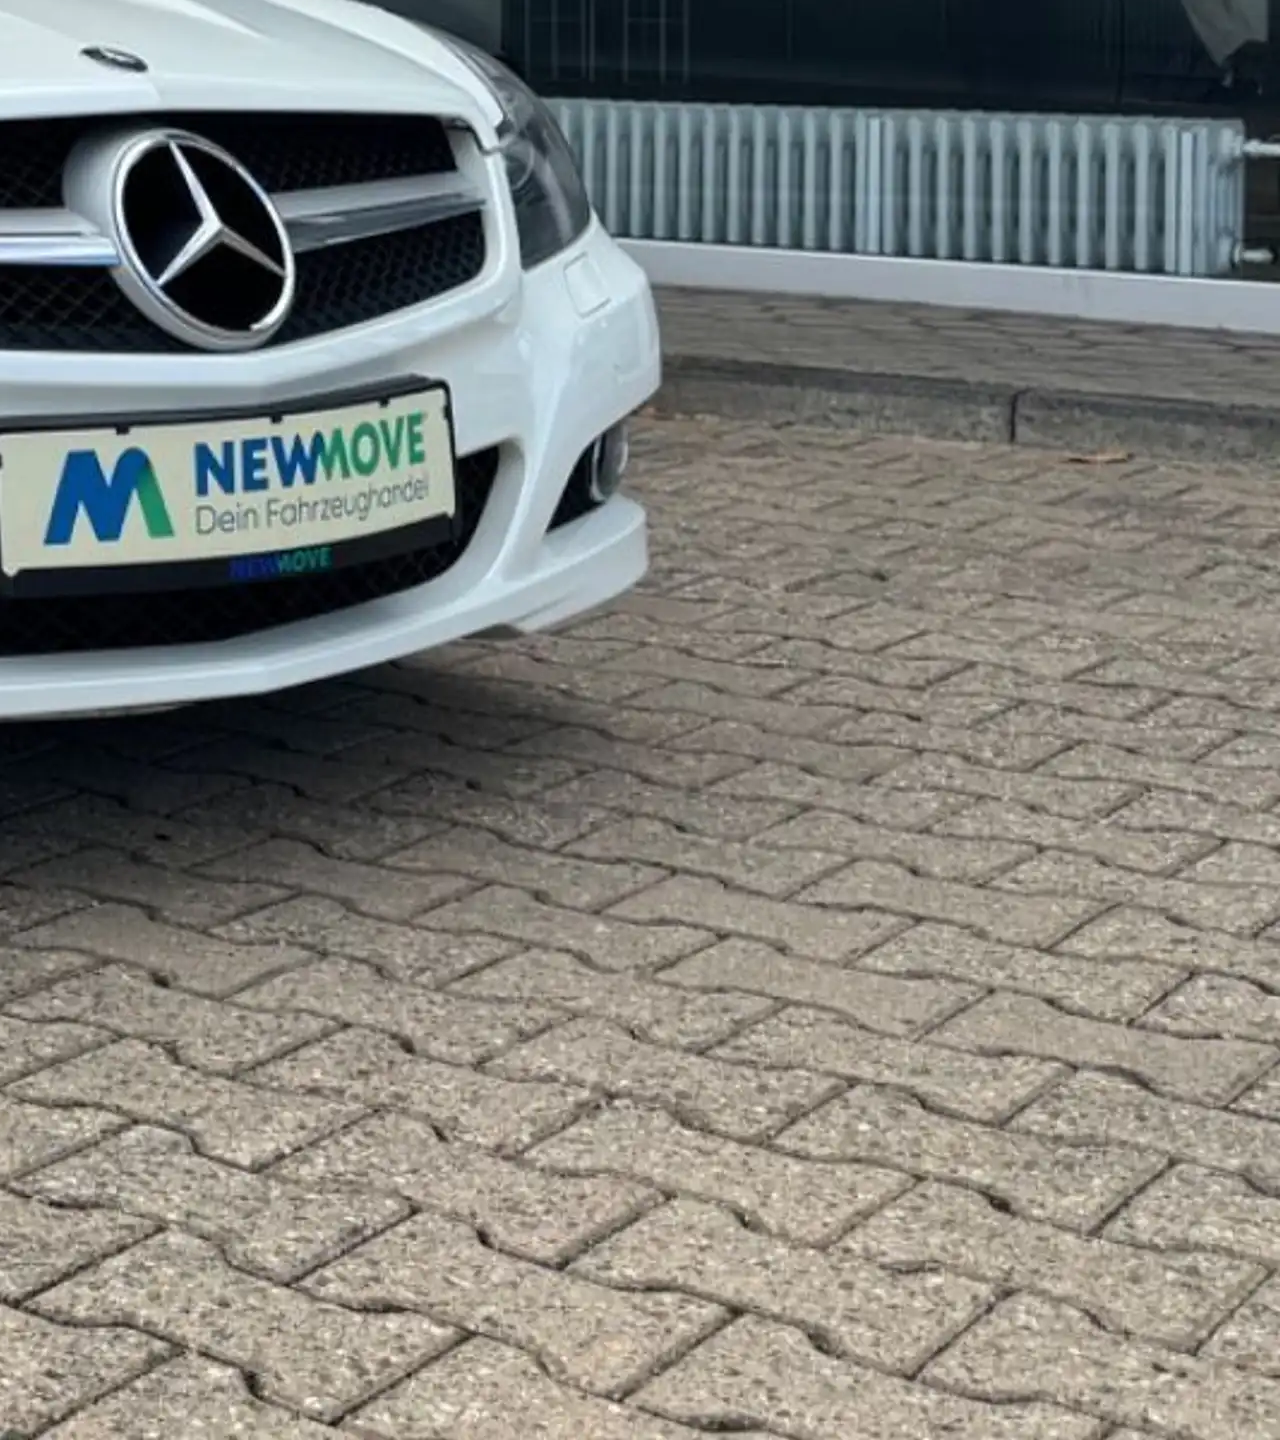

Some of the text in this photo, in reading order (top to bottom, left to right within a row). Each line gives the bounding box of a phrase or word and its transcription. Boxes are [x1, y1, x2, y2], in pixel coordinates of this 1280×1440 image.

[194, 412, 425, 497] NEWMOVE
[195, 471, 430, 535] Dein Fahrzeughandel
